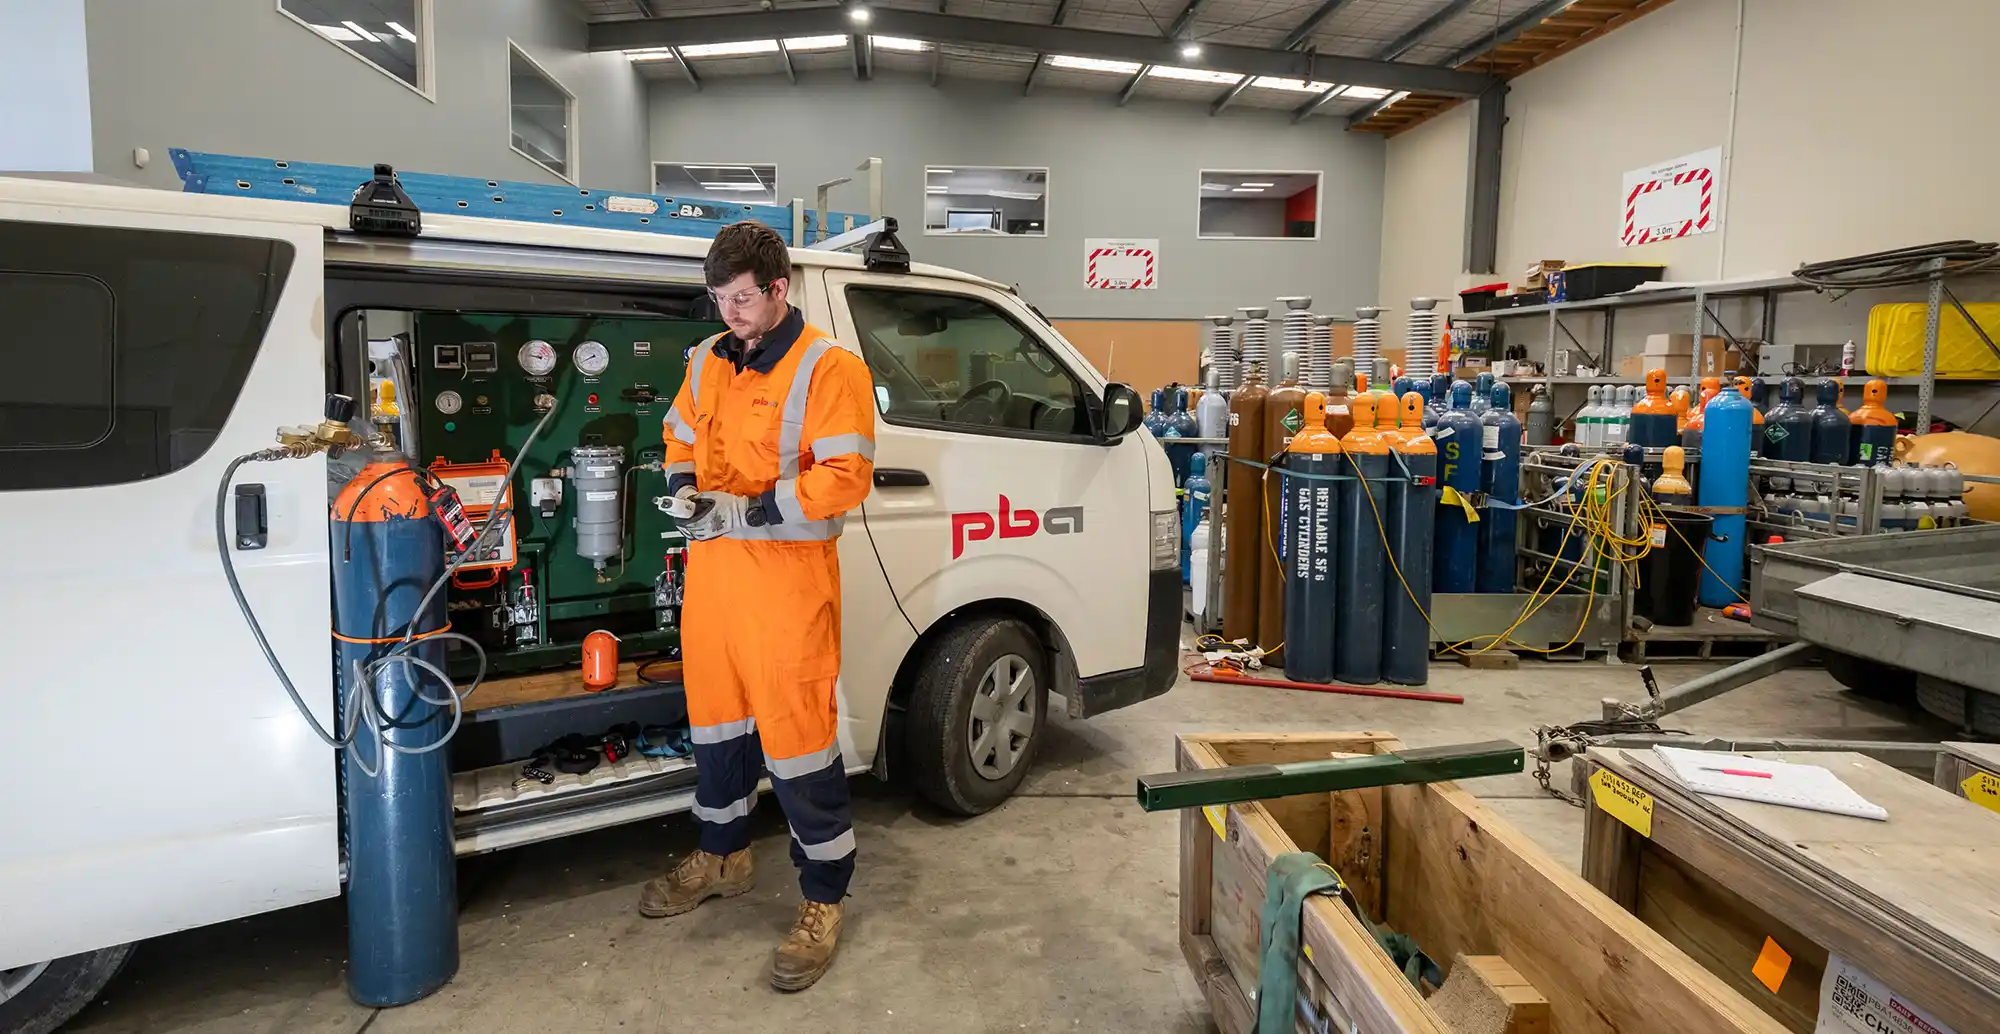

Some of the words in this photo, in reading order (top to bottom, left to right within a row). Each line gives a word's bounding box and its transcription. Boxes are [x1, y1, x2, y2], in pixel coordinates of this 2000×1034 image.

[1656, 227, 1674, 236] 3.0m
[951, 493, 1084, 561] pba
[1298, 487, 1312, 512] GAS
[1315, 487, 1330, 555] REFILLABLE
[1297, 516, 1312, 579] CYLINDERS
